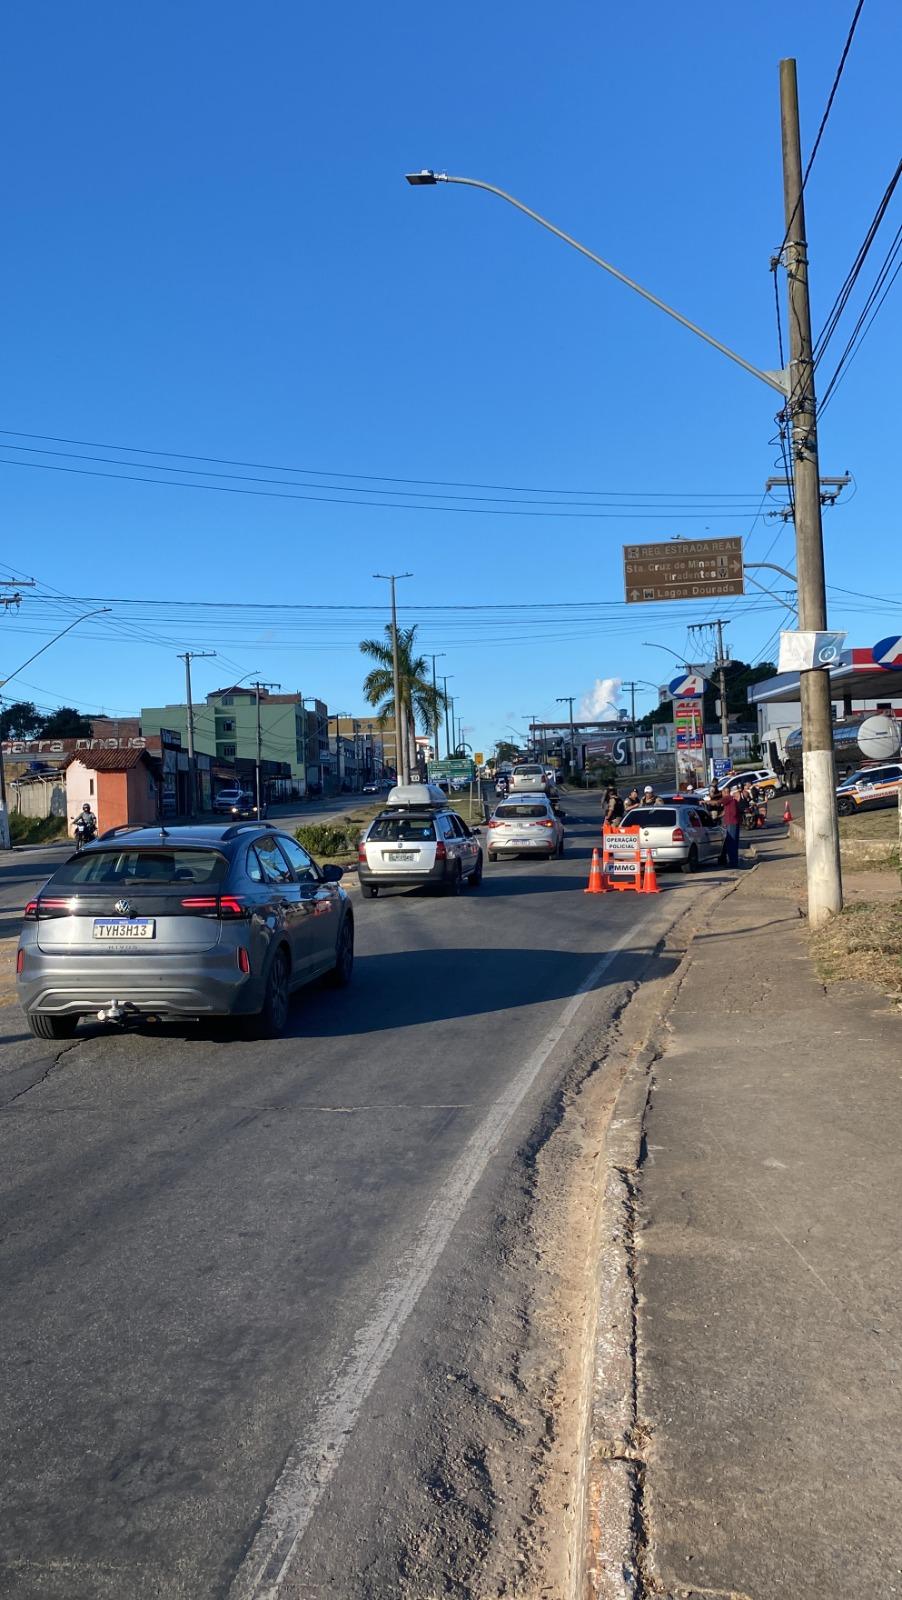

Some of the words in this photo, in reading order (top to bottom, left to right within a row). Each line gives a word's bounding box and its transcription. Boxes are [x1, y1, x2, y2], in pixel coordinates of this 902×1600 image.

[665, 543, 709, 555] ESTRADA
[712, 541, 738, 551] REAL
[648, 562, 671, 572] Cruz
[674, 560, 685, 569] de
[688, 559, 716, 569] Minas
[664, 570, 717, 581] Tiradentes
[657, 588, 688, 599] Lagoa
[692, 584, 735, 595] Dourada
[98, 925, 147, 936] TYH3H13
